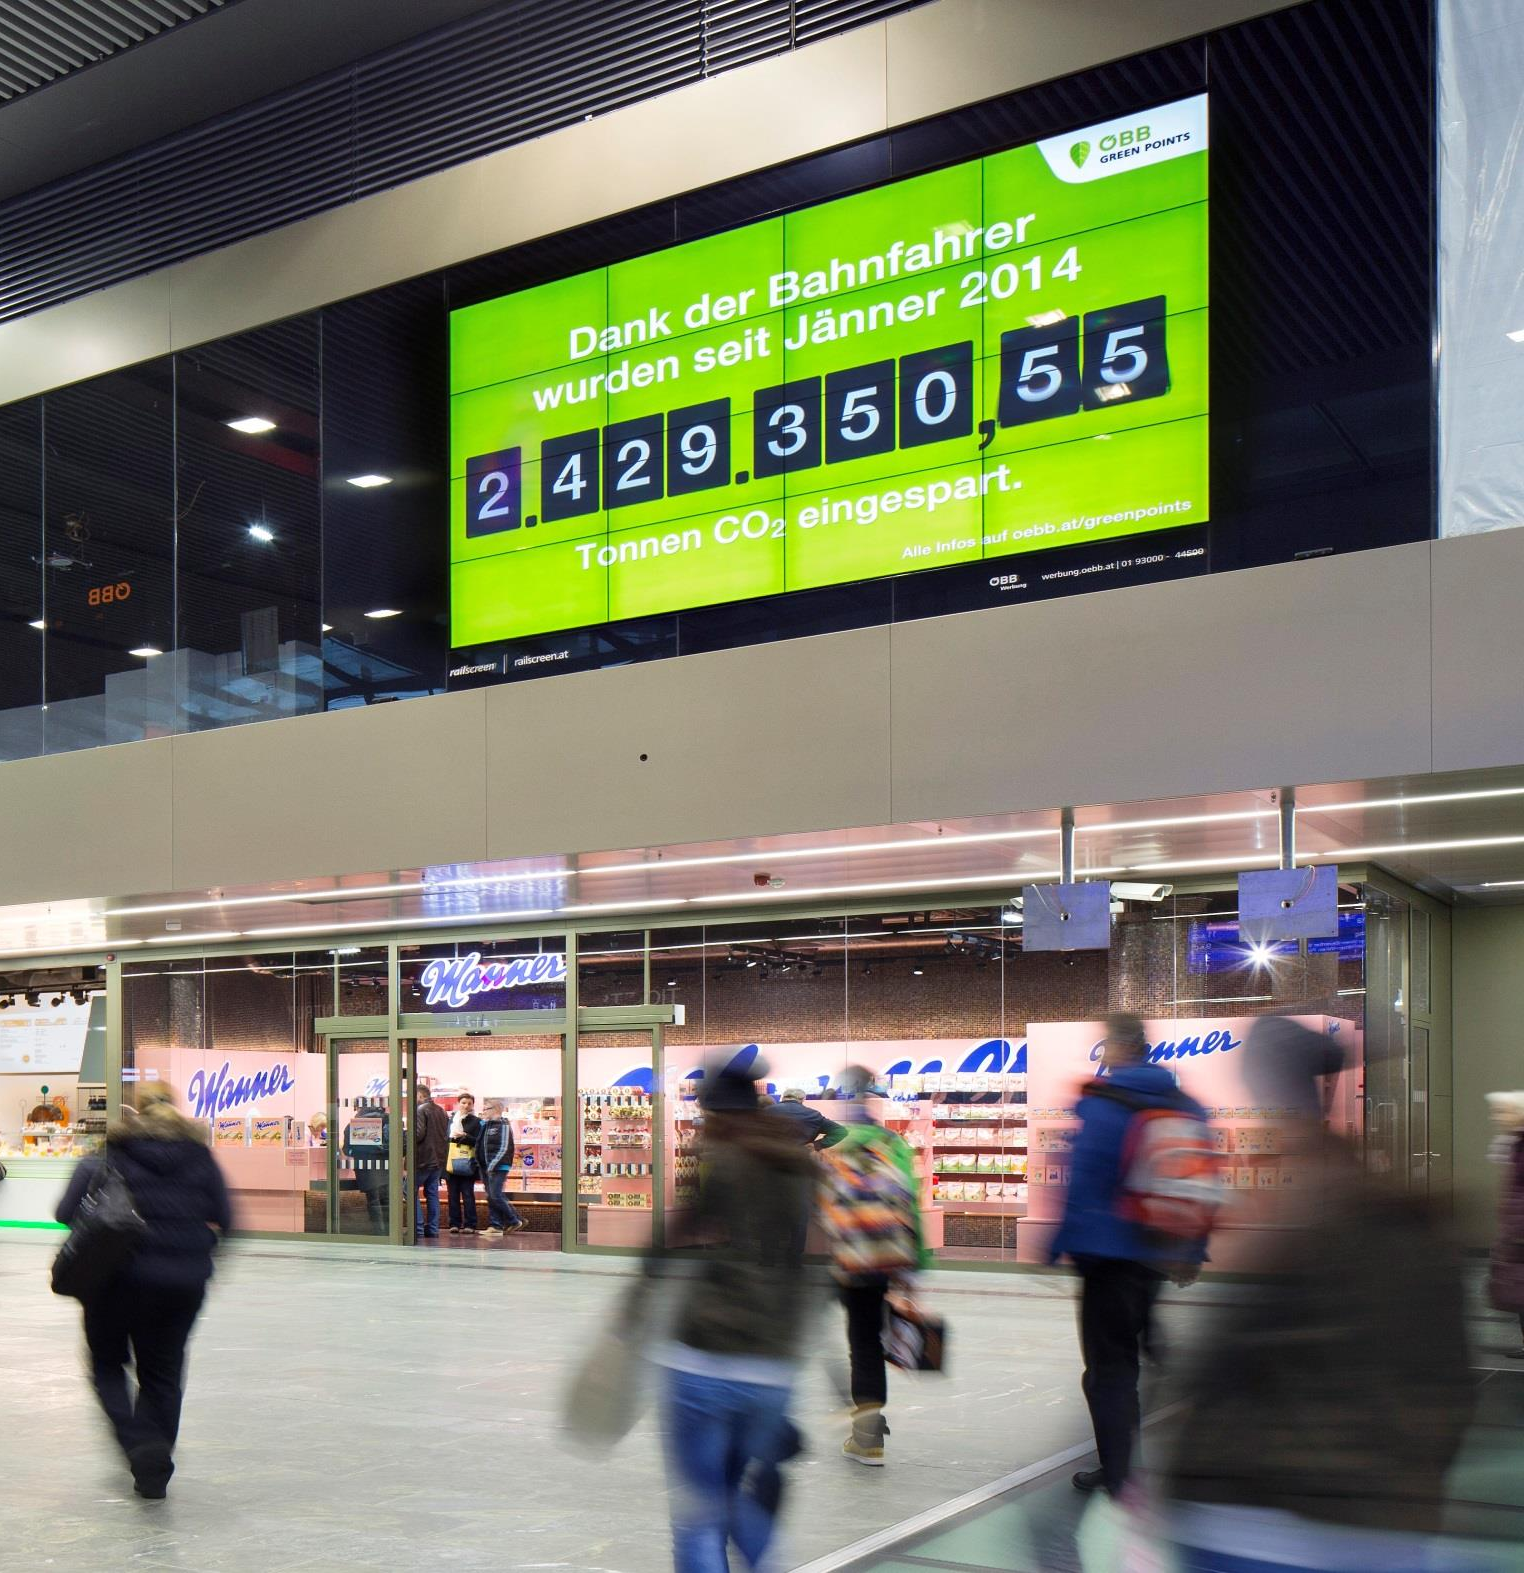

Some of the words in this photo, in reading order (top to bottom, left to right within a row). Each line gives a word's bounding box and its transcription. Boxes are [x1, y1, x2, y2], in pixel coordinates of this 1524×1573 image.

[1098, 125, 1151, 152] ÖBB
[1099, 146, 1140, 164] GREEN
[1145, 131, 1191, 152] POINTS
[569, 308, 672, 361] Dank
[683, 288, 755, 329] der
[769, 213, 1036, 309] Bahnfahrer
[532, 358, 680, 412] wurden
[693, 327, 771, 373] seit
[784, 287, 945, 351] Jänner
[959, 246, 1082, 309] 2014
[575, 528, 702, 570] Tonnen
[797, 463, 1023, 529] eingespart.
[902, 543, 932, 560] Alle
[935, 537, 976, 554] Infos
[981, 529, 1008, 545] auf
[1012, 498, 1192, 541] oebb.at/greenpoints
[1000, 582, 1027, 592] Werbung
[1041, 561, 1115, 582] werbung.oebb.at
[1121, 559, 1132, 568] 01
[1135, 554, 1164, 566] 93000
[449, 661, 496, 677] railscreen
[514, 650, 569, 667] railscreen.at
[422, 953, 566, 1006] Manner
[1089, 1029, 1242, 1079] nner
[188, 1061, 295, 1127] Manner
